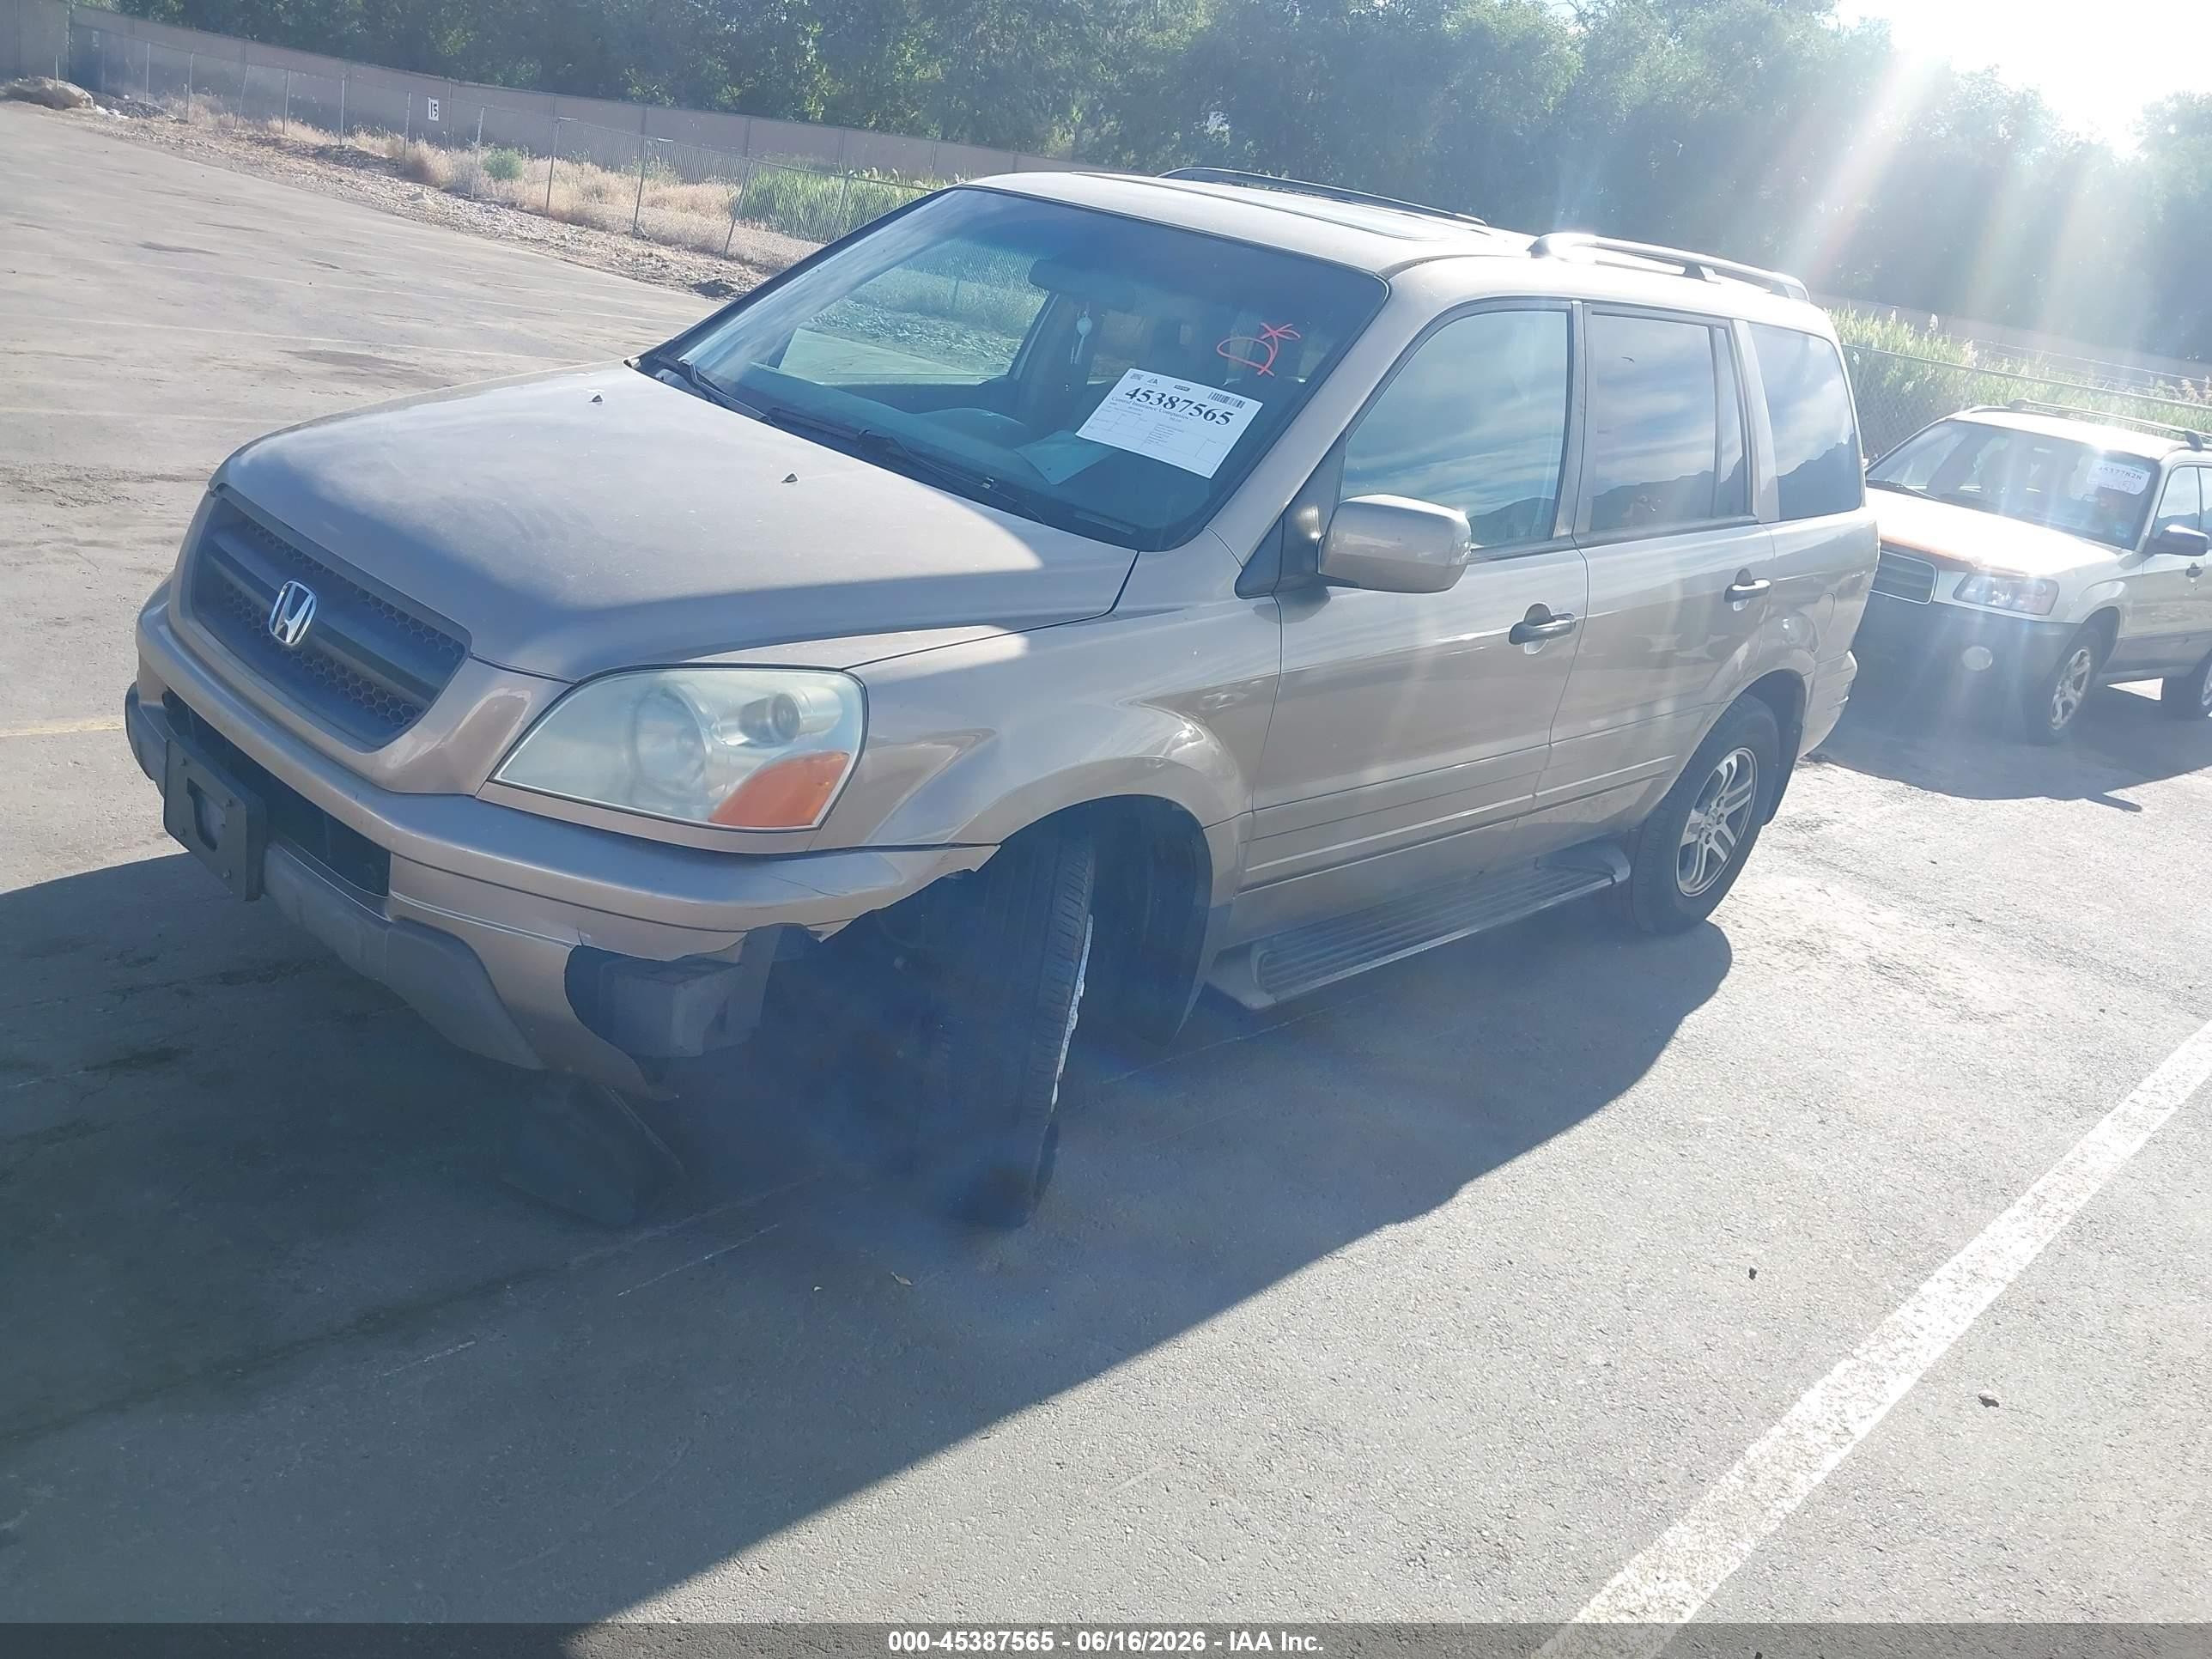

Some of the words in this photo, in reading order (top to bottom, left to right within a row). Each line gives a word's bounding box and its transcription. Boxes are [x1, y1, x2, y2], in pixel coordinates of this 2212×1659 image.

[430, 102, 437, 117] 15
[1125, 386, 1235, 426] 45387565
[1132, 400, 1157, 411] Insurance
